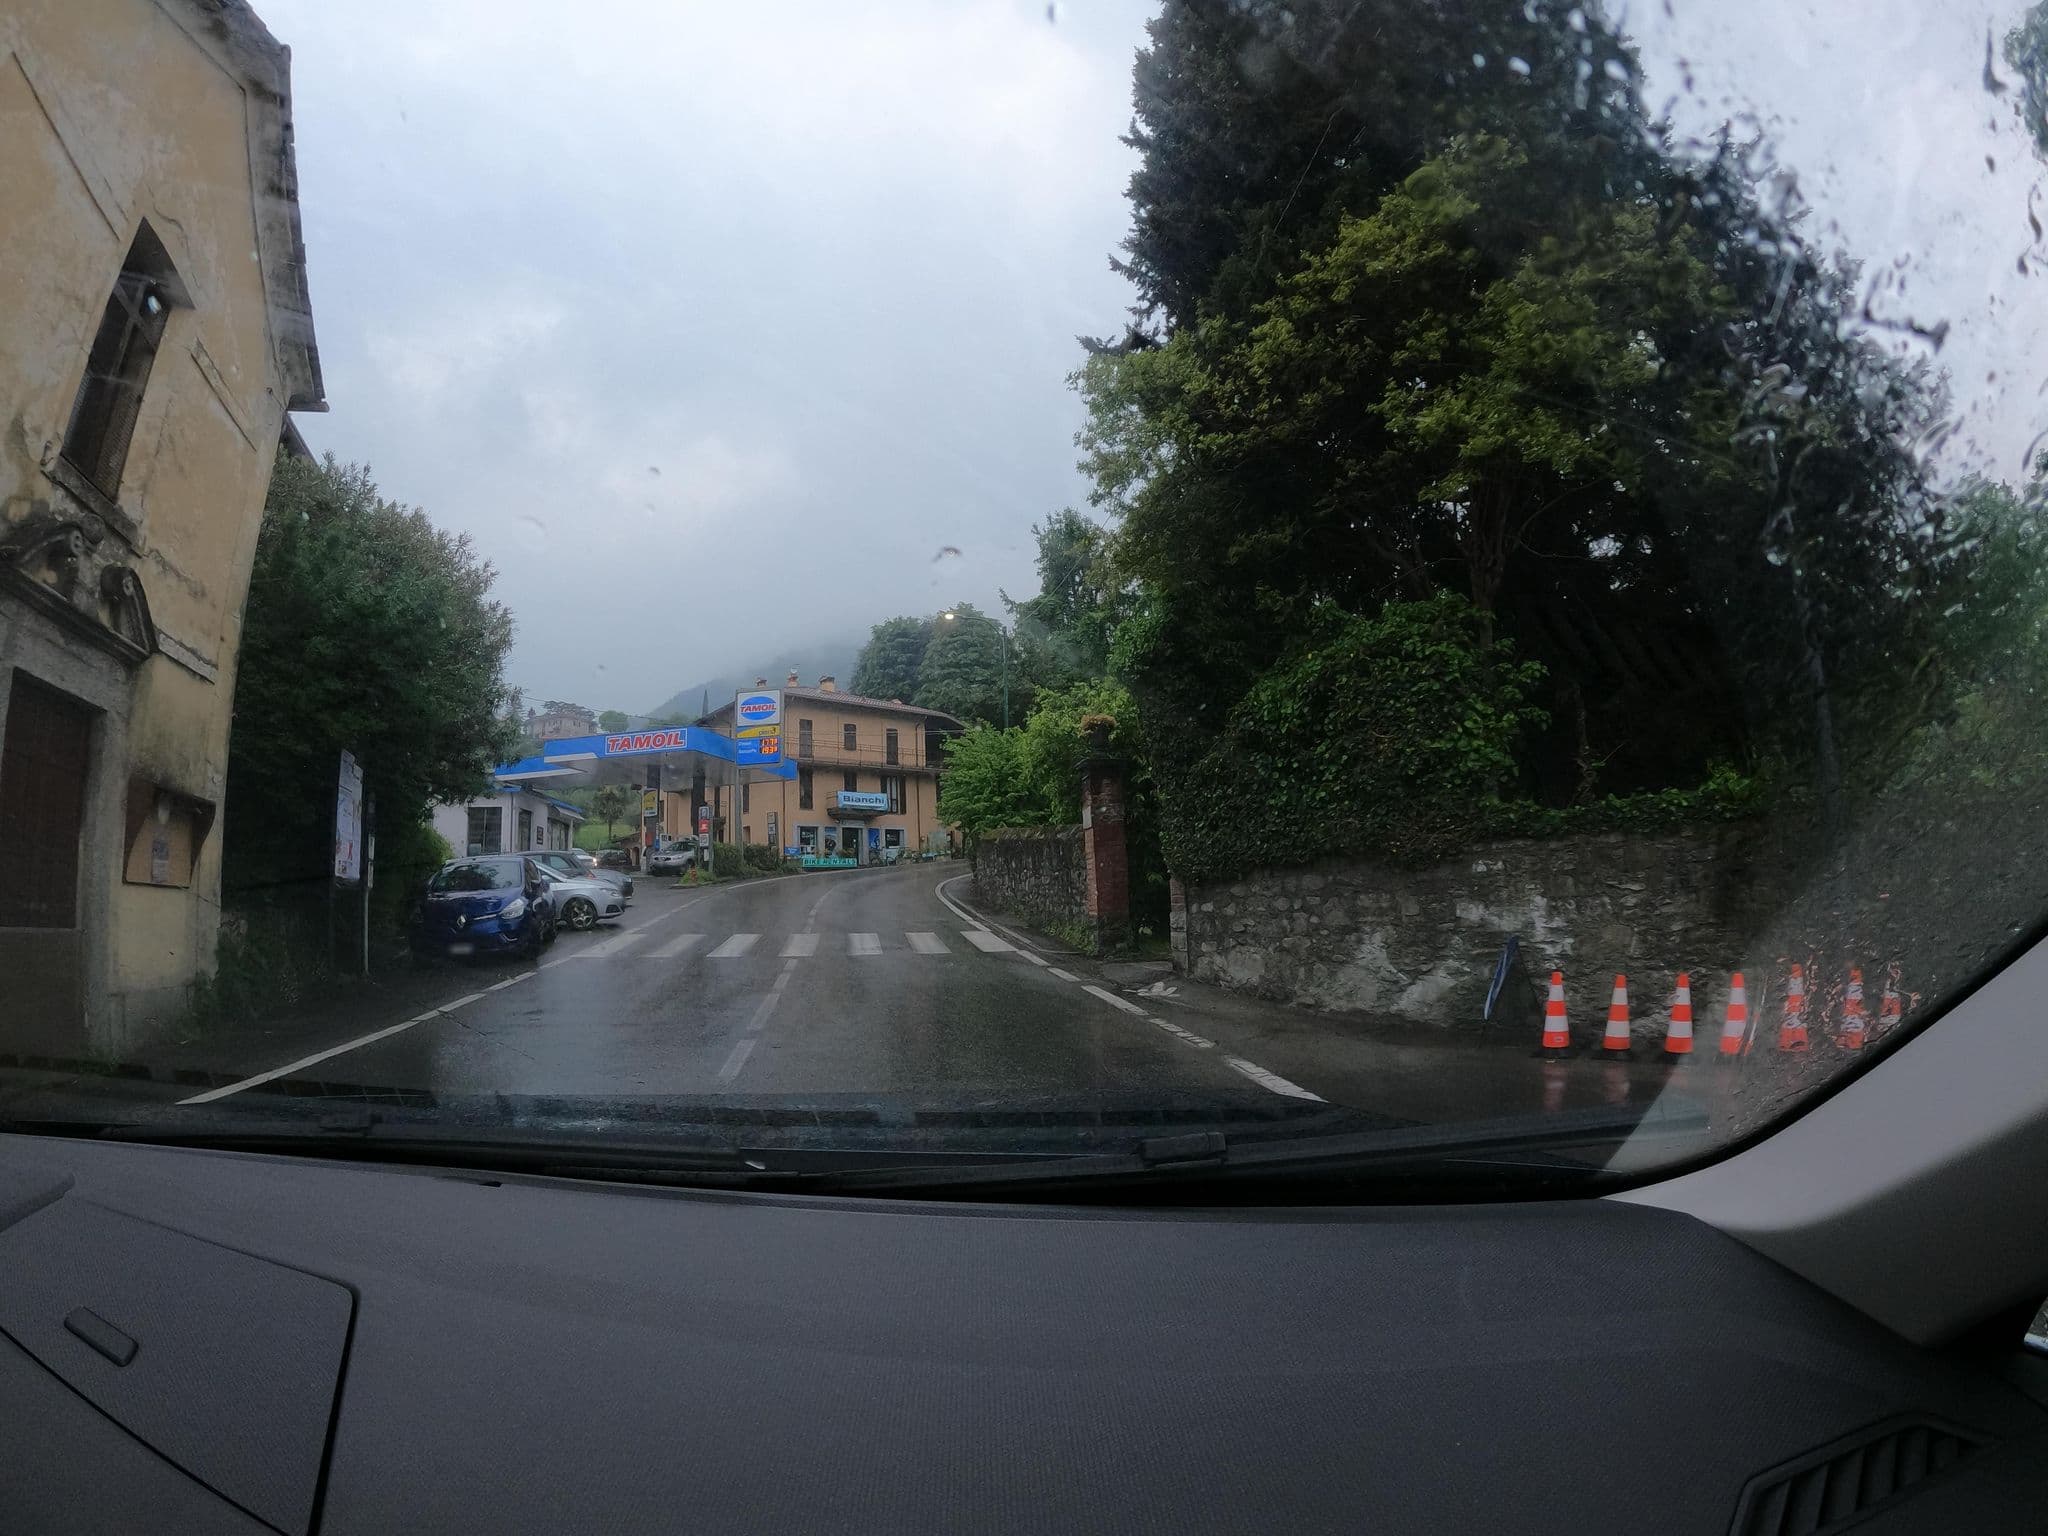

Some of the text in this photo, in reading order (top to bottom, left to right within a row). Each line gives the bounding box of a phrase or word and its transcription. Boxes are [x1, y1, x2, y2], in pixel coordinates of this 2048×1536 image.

[740, 704, 777, 713] TAMOIL
[608, 732, 684, 751] TAMOIL
[843, 795, 885, 805] Bianchi
